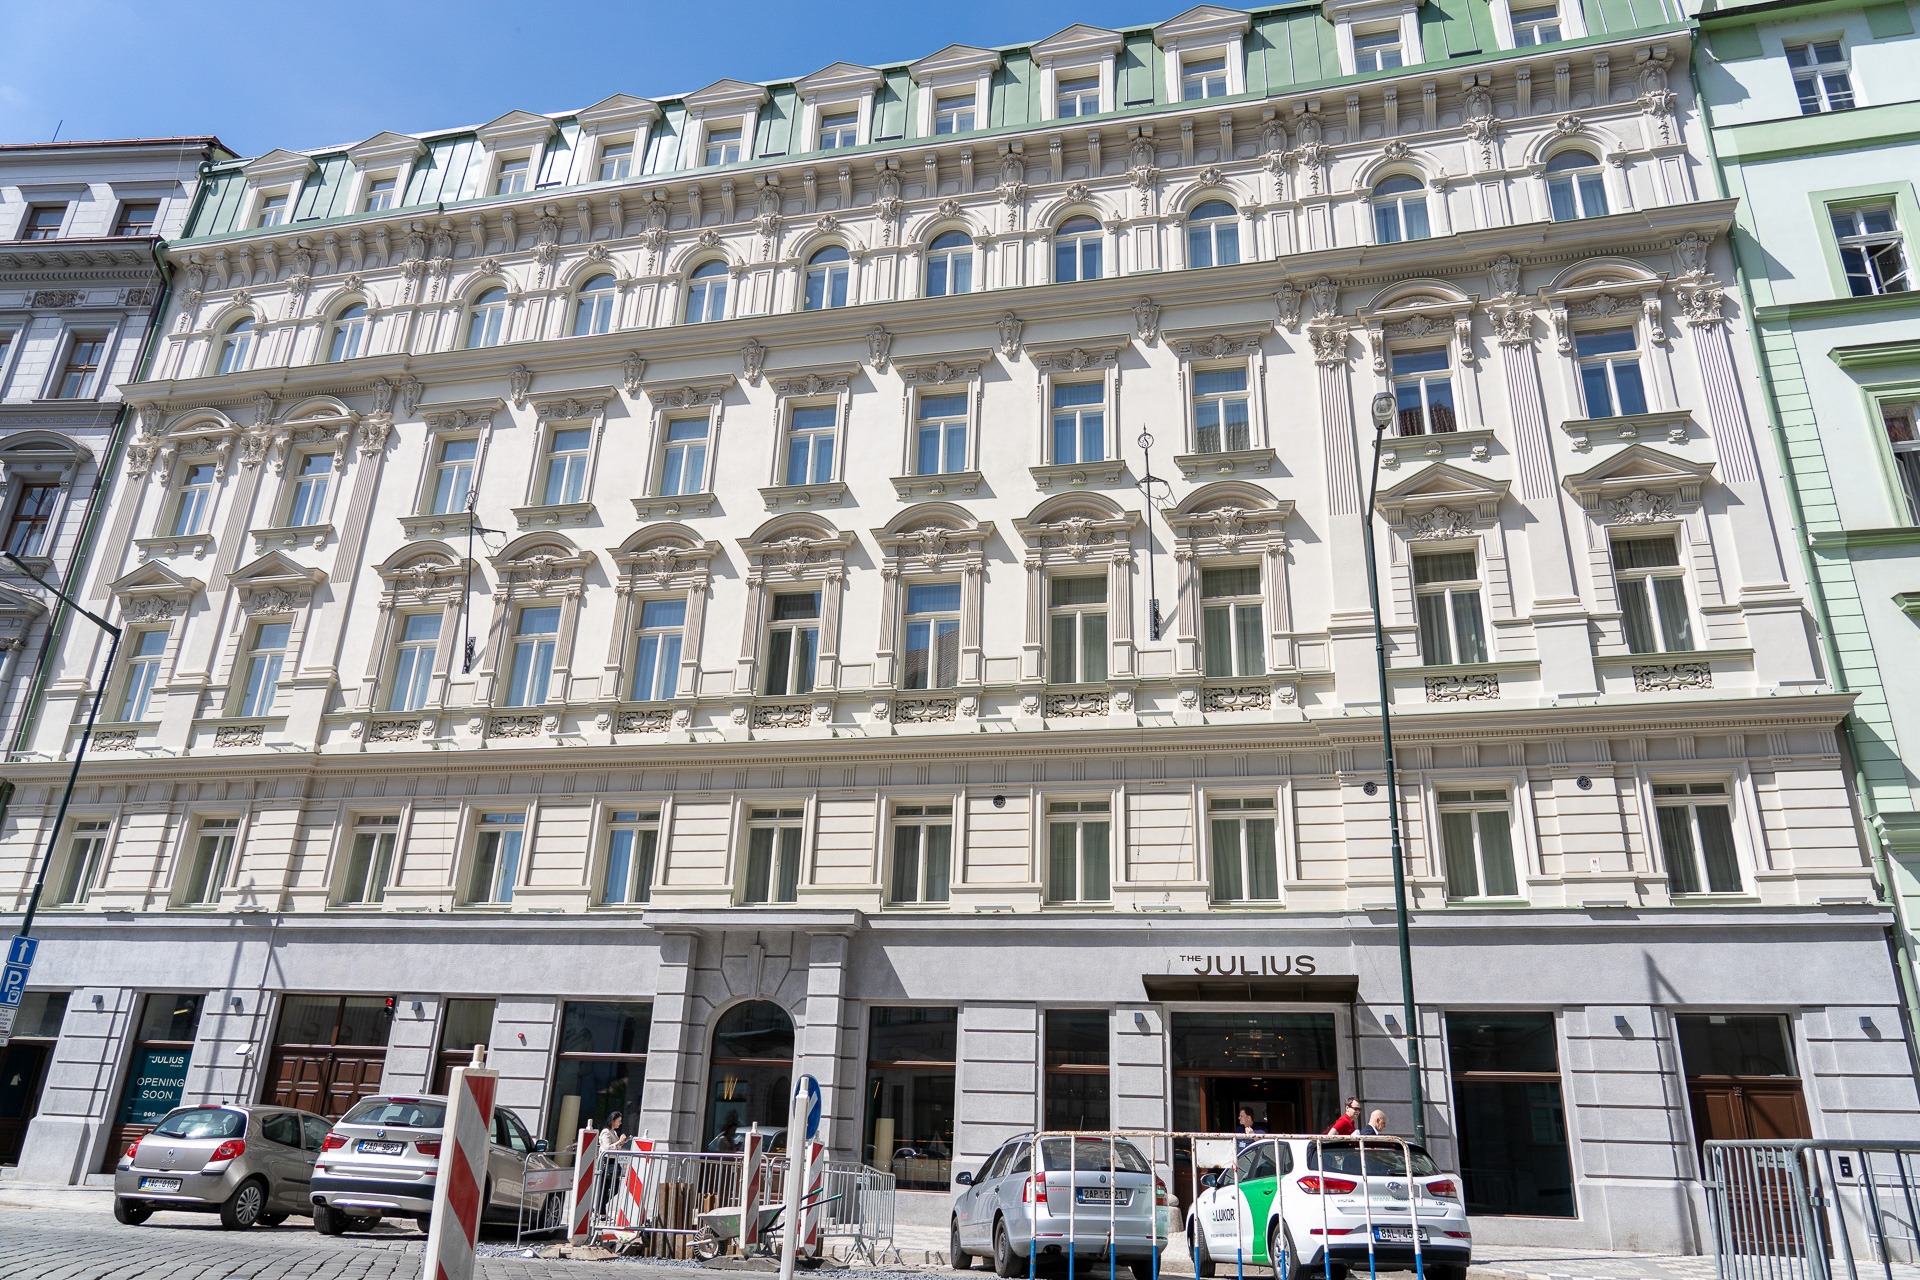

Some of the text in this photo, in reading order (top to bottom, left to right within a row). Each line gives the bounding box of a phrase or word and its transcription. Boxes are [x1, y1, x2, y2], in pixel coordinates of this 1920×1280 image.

[1194, 955, 1316, 976] JULIUS
[4, 970, 23, 993] P
[151, 1056, 185, 1065] JULIUS
[136, 1077, 185, 1088] OPENING
[141, 1089, 174, 1100] SOON
[1084, 1189, 1098, 1199] 2AP
[1216, 1208, 1236, 1222] LUKOR
[1380, 1228, 1424, 1239] 8AL 453
